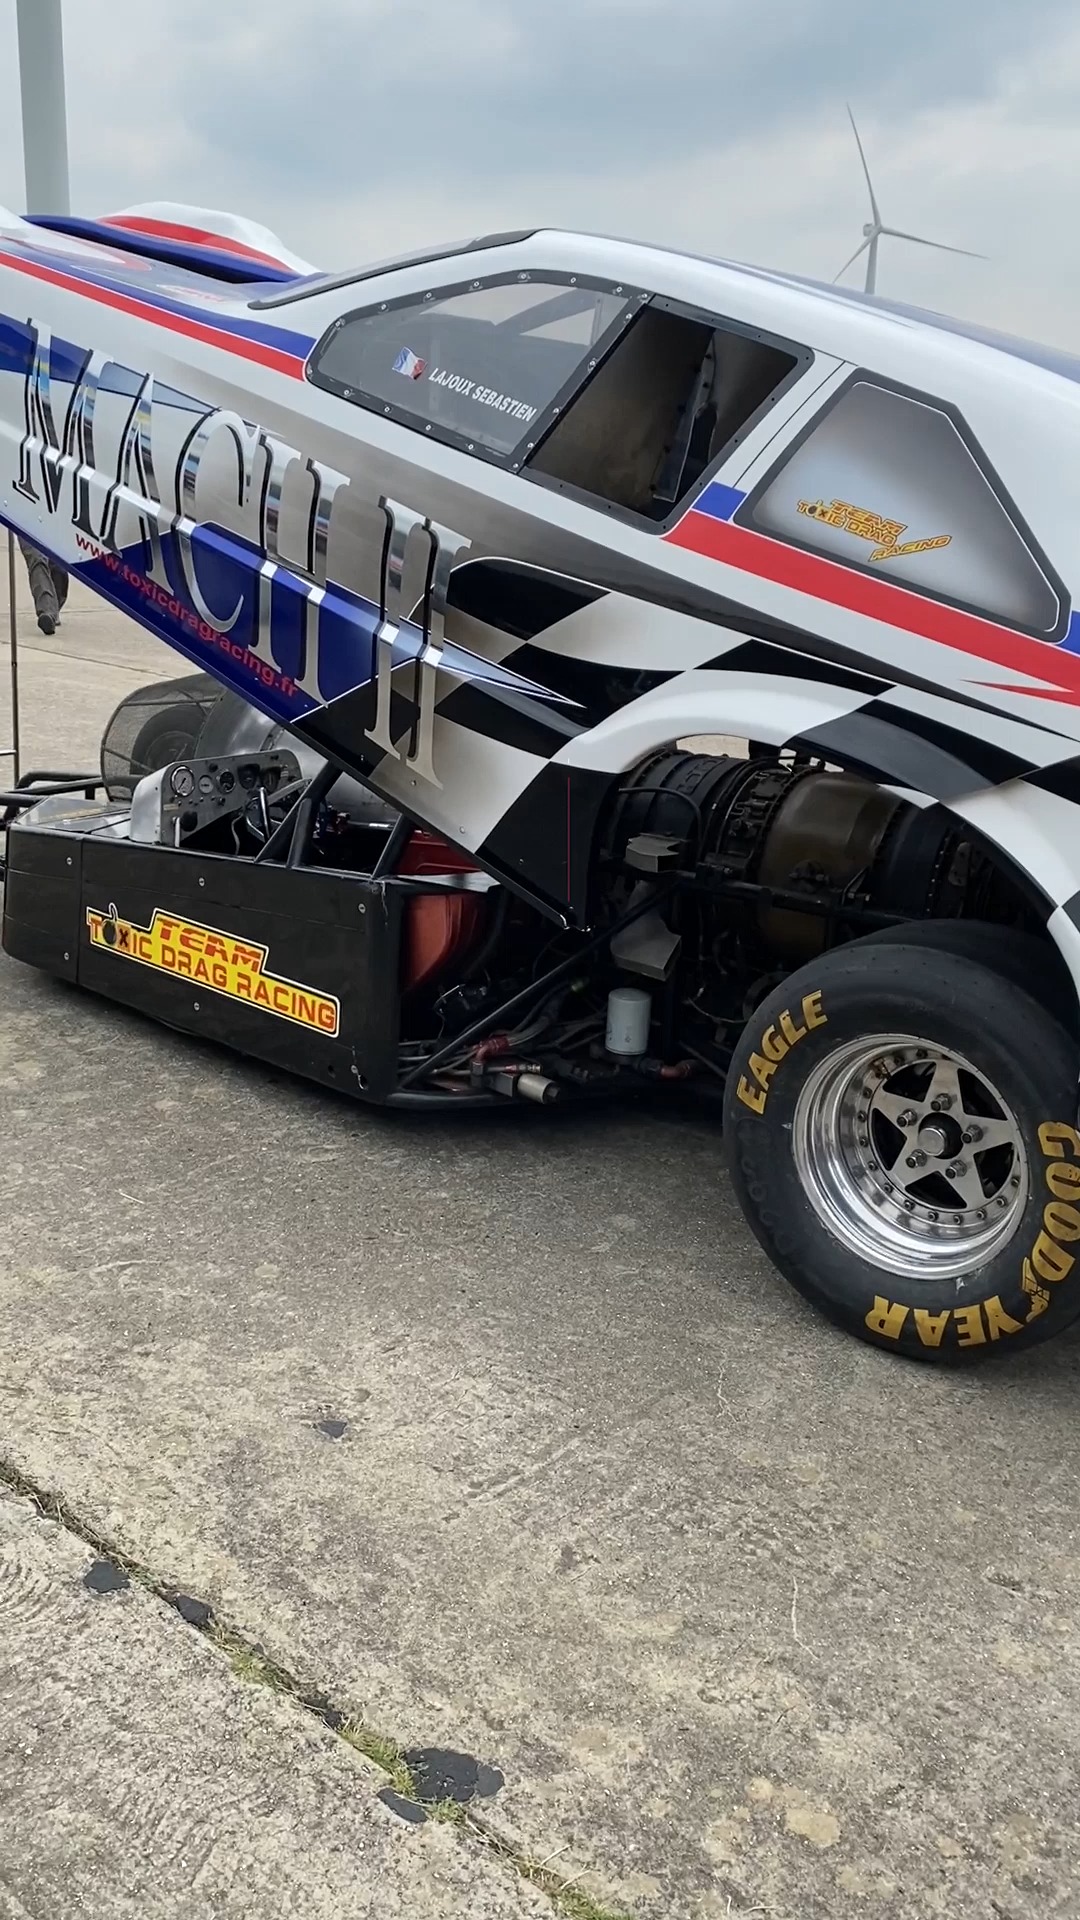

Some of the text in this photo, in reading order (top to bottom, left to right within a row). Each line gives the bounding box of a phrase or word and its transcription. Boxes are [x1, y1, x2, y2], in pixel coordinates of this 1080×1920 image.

[428, 367, 538, 422] LAJOUX SEBASTIEN
[12, 318, 350, 709] MACH
[832, 501, 905, 535] TEAM
[848, 520, 897, 546] DRAG
[870, 537, 950, 561] RACING
[75, 533, 299, 698] www.toxicdragracing.fr
[88, 914, 337, 1030] TOXIC DRAG RACING
[157, 917, 261, 973] TEAM
[737, 989, 828, 1115] EAGLE
